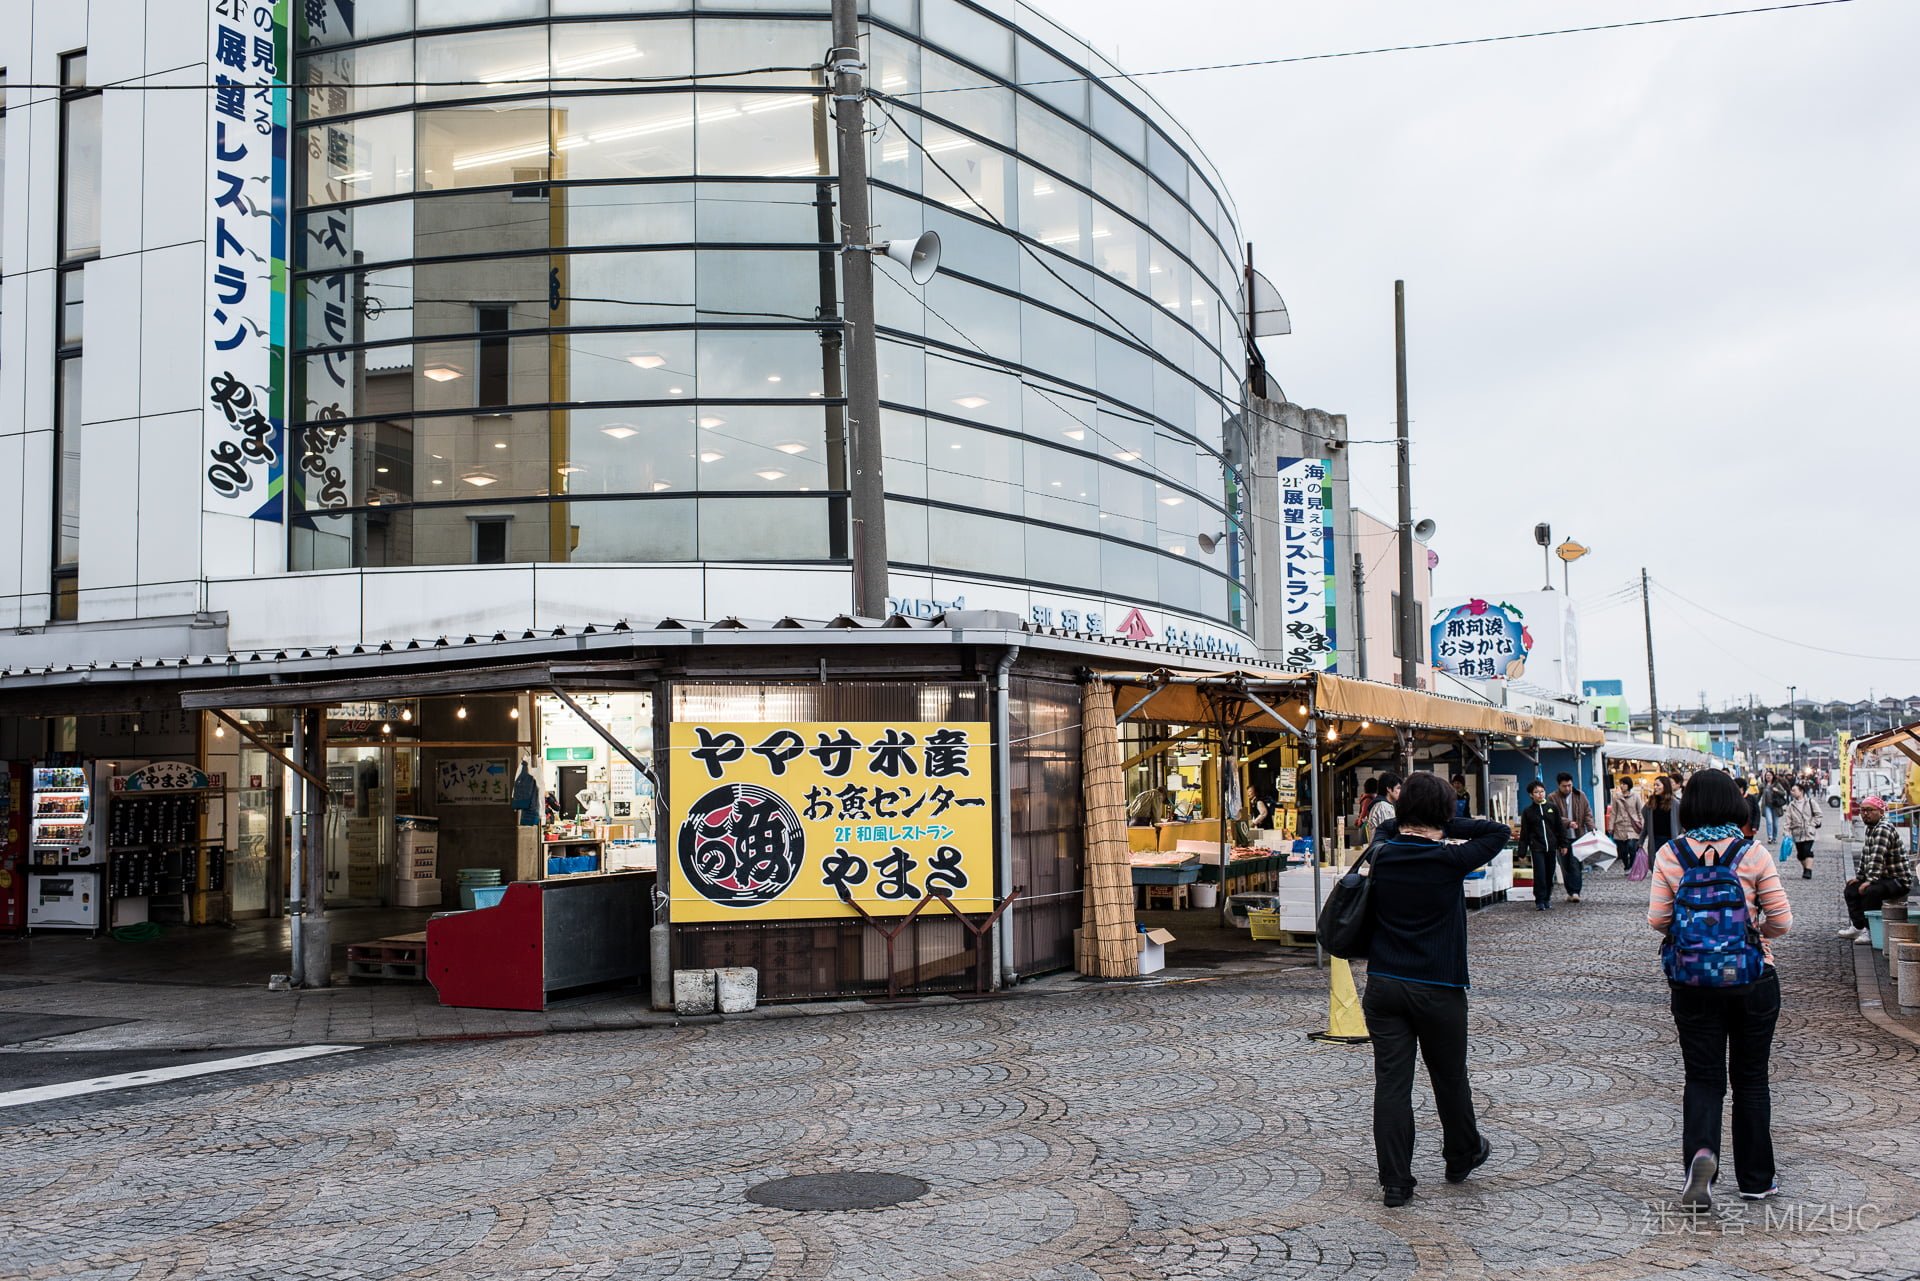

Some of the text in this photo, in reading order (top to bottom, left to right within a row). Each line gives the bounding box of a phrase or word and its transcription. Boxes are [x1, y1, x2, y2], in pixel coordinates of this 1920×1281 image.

[253, 0, 276, 135] の見える
[214, 24, 248, 350] 展望レストラン
[209, 371, 275, 491] やまさ
[1304, 464, 1325, 537] 海の見える
[1282, 477, 1309, 615] 2F 展望レストラン
[1286, 620, 1331, 667] やまさ
[1439, 638, 1513, 657] おさかな
[1457, 657, 1497, 677] 市場
[690, 727, 972, 780] ヤマサ水産
[145, 772, 189, 789] やまさ
[802, 782, 986, 822] お魚センター
[834, 825, 955, 842] 2F 和風レストラン
[821, 846, 969, 903] やまさ
